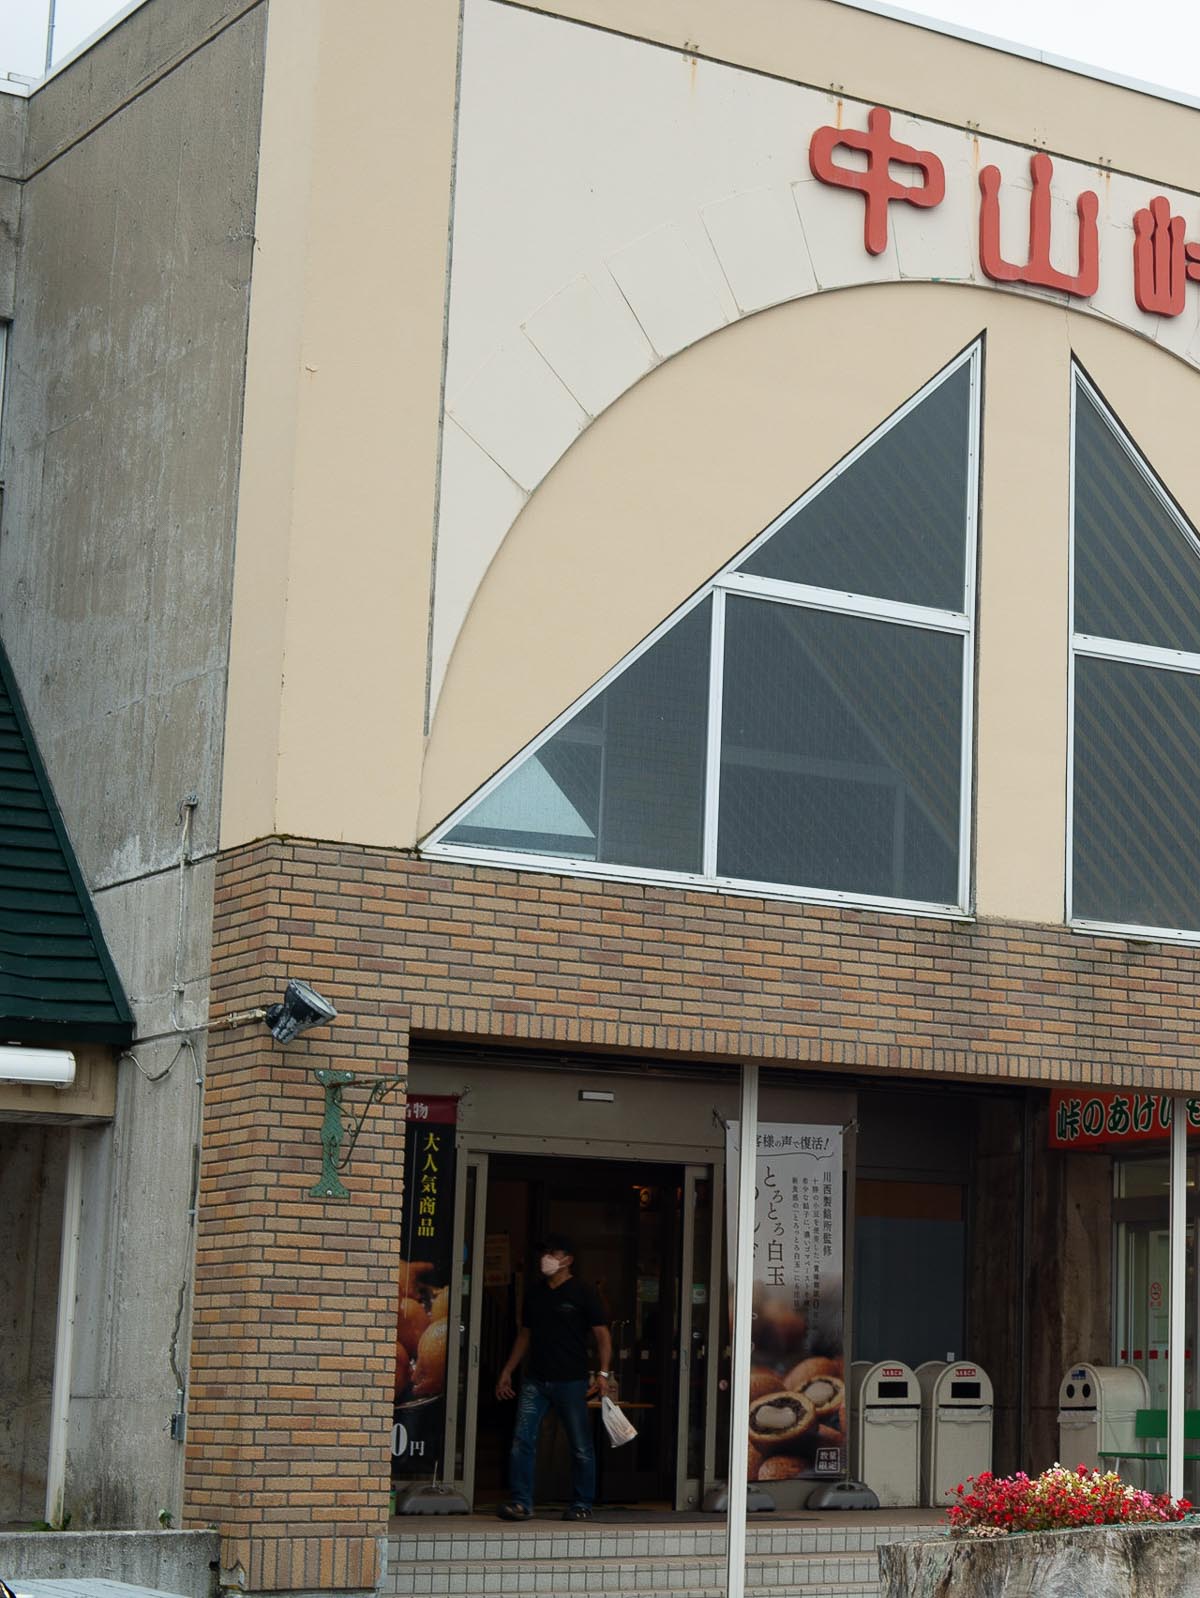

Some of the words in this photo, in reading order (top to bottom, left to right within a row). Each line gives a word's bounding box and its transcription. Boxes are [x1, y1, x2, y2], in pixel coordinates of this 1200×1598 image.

[417, 1132, 440, 1237] 大人気商品
[763, 1166, 786, 1288] とろとろ白玉
